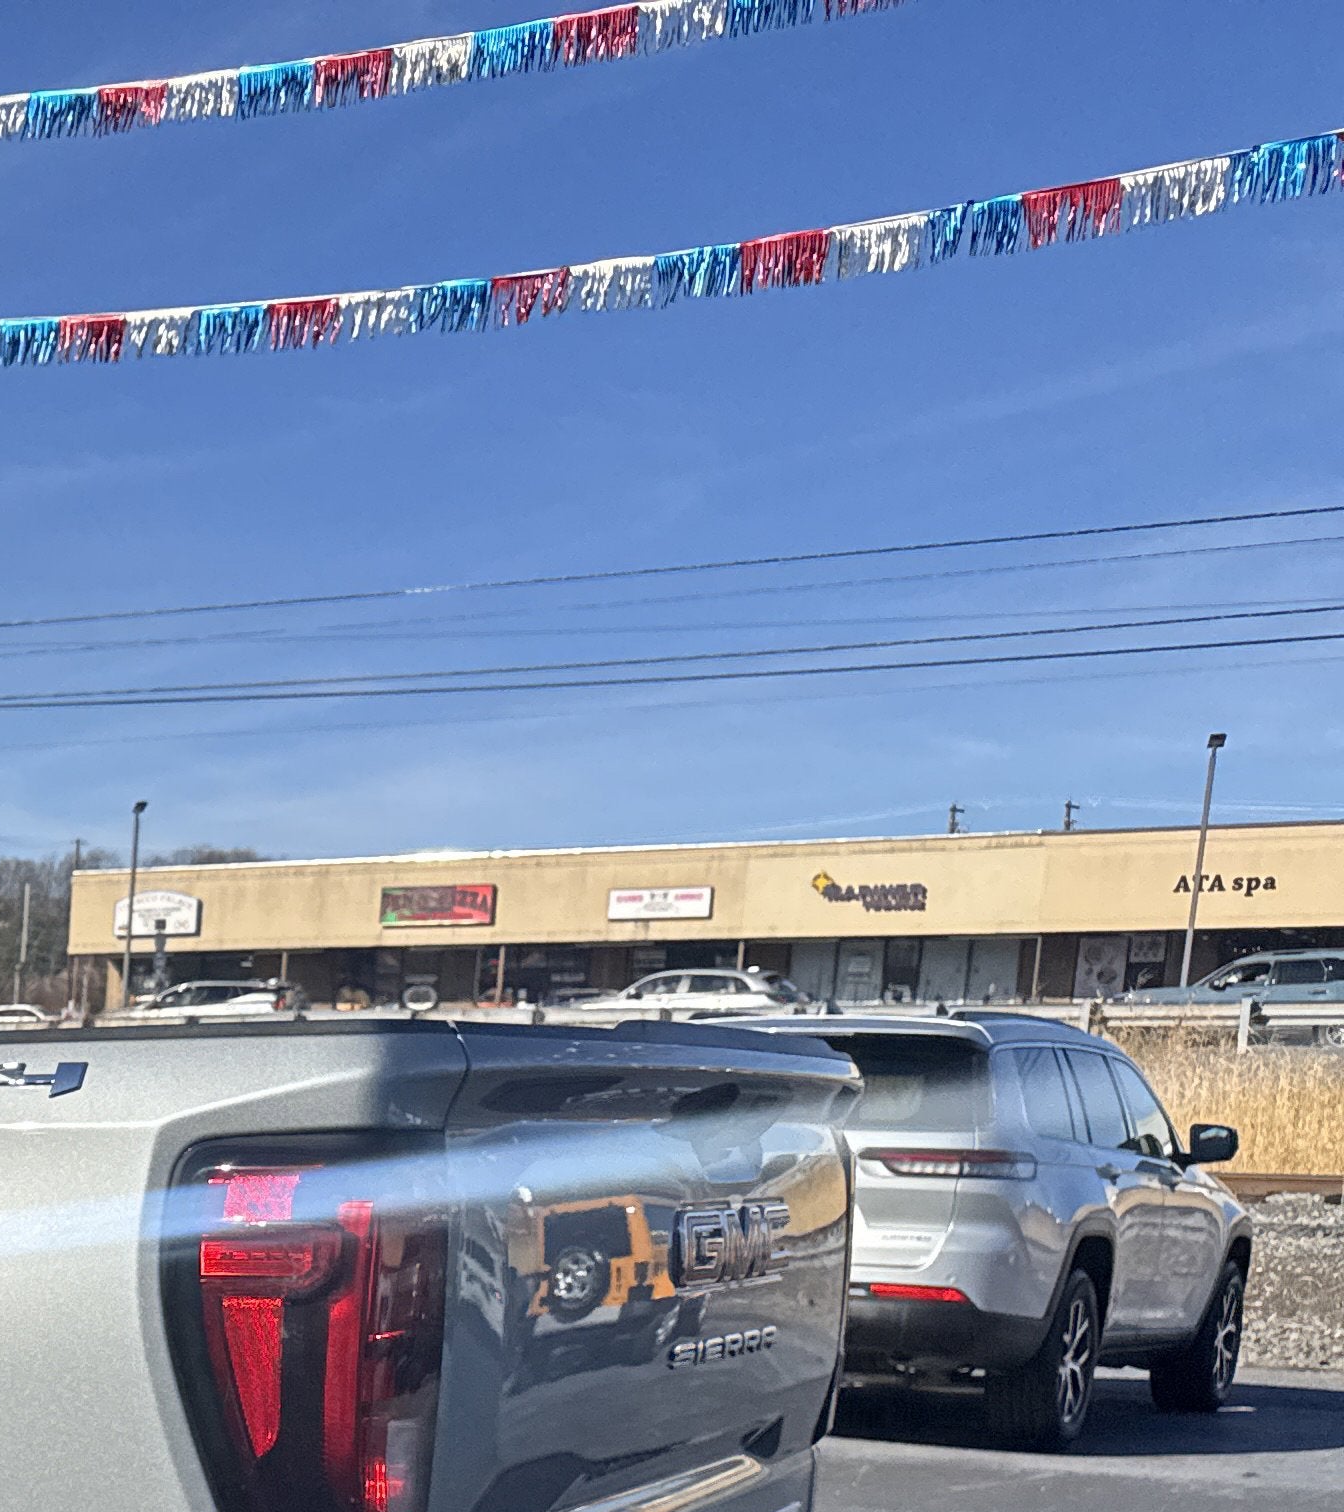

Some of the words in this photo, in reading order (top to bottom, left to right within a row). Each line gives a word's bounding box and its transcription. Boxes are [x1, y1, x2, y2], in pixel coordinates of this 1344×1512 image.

[1173, 874, 1226, 893] ATA
[1231, 876, 1277, 897] spa
[669, 1203, 790, 1288] GMC
[667, 1325, 777, 1370] SIERRA
